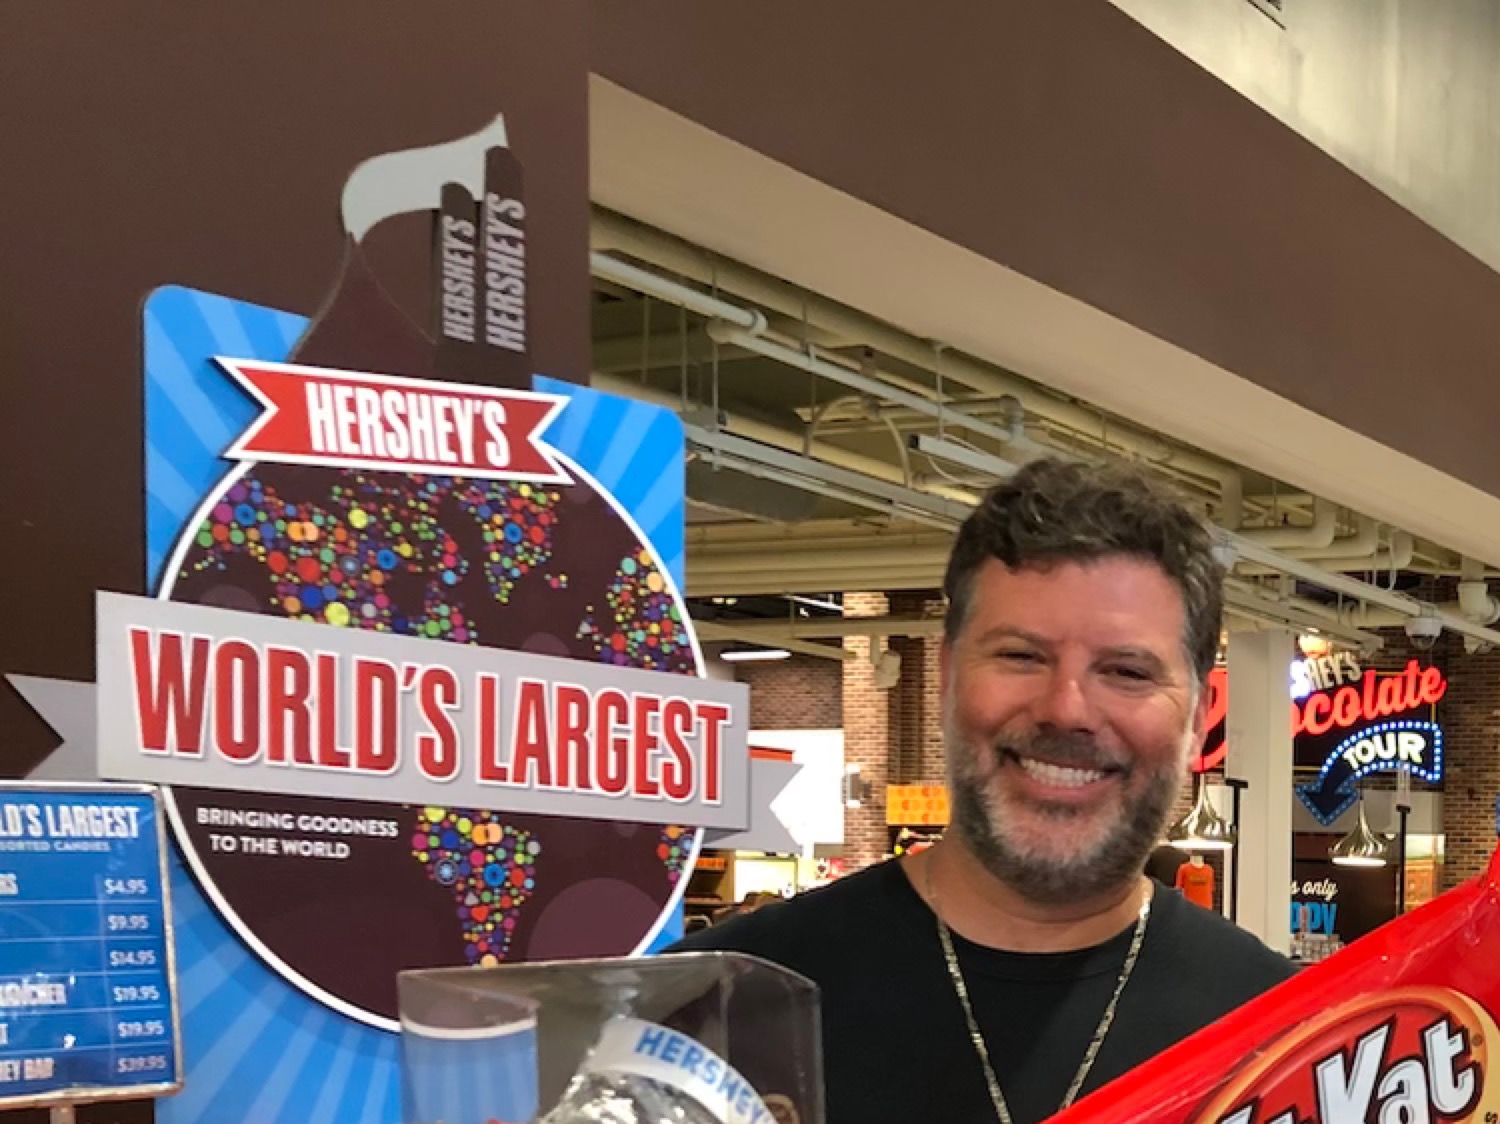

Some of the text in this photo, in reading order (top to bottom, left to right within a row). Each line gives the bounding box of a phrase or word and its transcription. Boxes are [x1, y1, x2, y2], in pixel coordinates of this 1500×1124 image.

[442, 215, 476, 343] HERSHEY'S
[485, 191, 525, 353] HERSHEY'S
[304, 381, 511, 468] HERSHEY'S
[1290, 651, 1362, 698] SHEY'S
[127, 626, 731, 804] WORLD'S LARGEST
[1290, 659, 1448, 738] colate
[1342, 732, 1426, 770] TOUR
[45, 804, 140, 839] LARGEST
[196, 807, 399, 837] BRINGING GOODNESS
[209, 833, 351, 859] TO THE WORLD
[104, 877, 148, 895] $4.95
